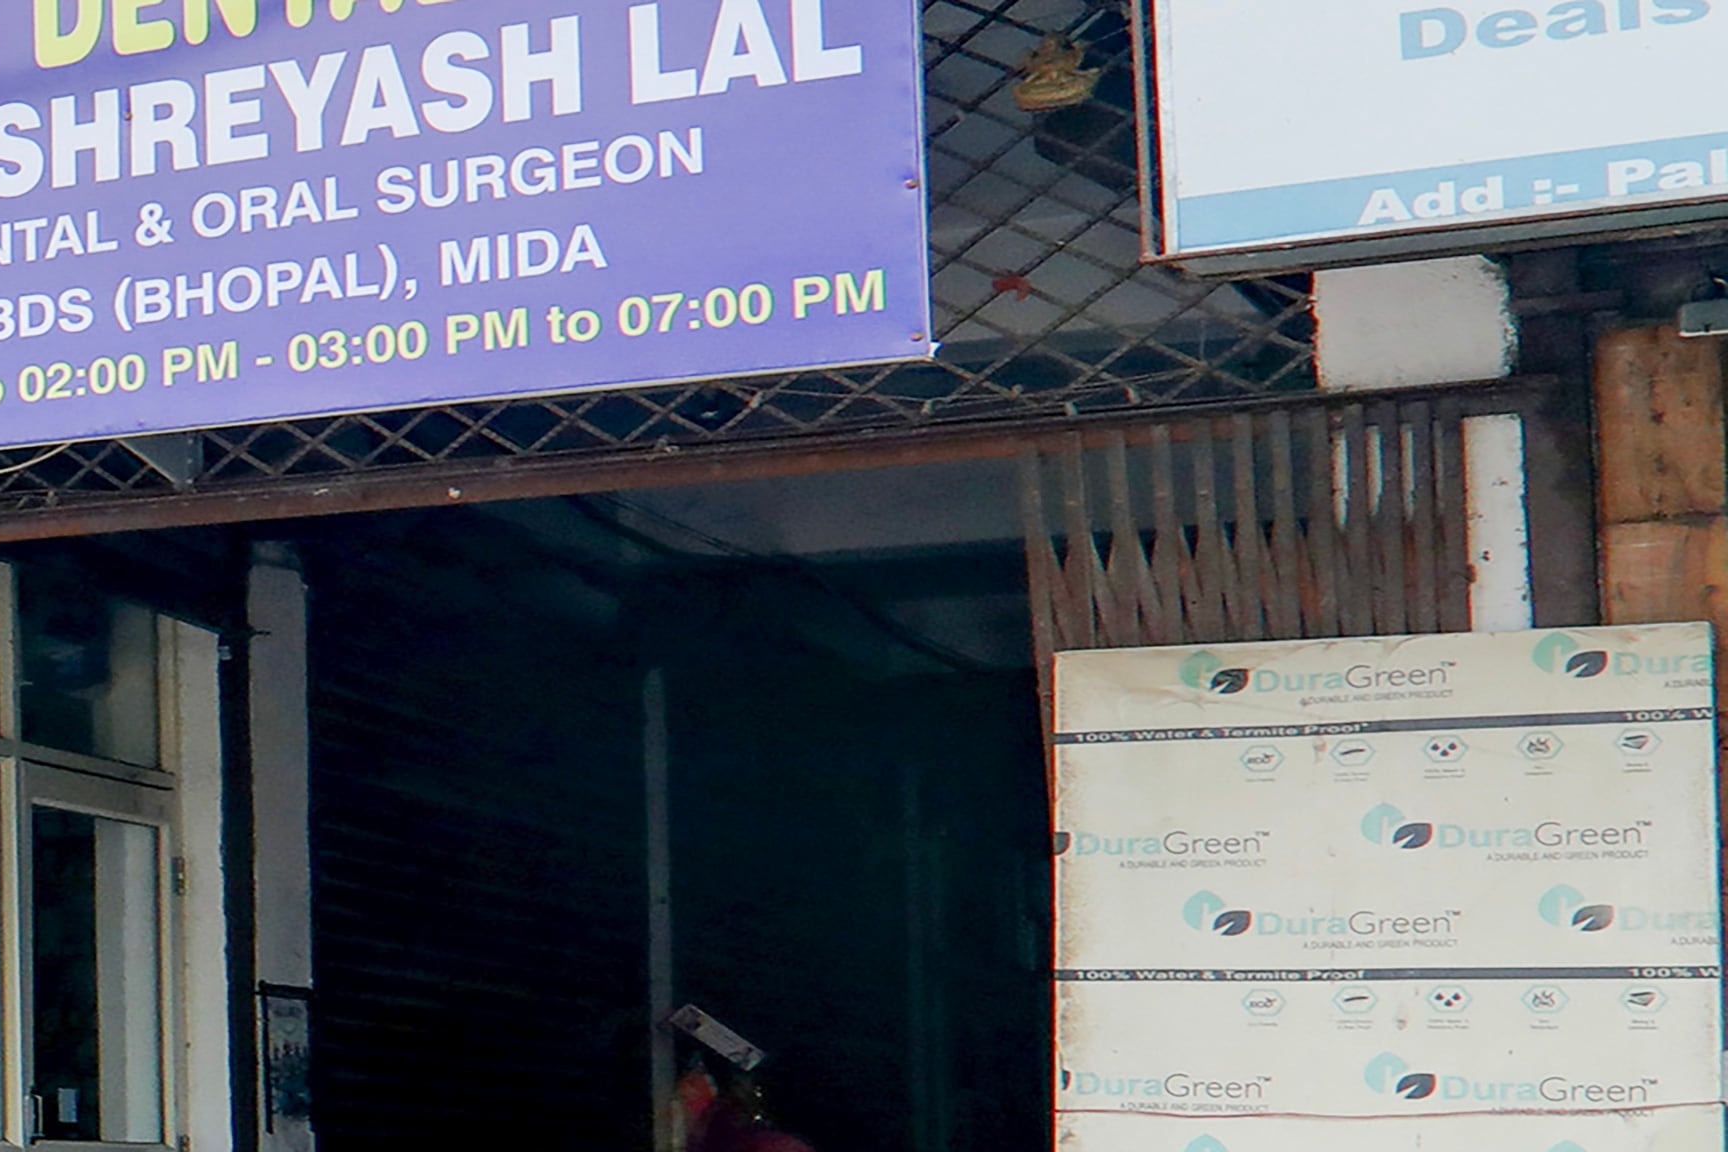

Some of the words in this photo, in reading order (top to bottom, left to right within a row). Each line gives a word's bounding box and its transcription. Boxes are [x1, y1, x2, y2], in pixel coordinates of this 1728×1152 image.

[628, 0, 863, 104] LAL
[135, 201, 174, 247] &
[191, 175, 359, 240] ORAL
[376, 127, 704, 214] SURGEON
[1357, 177, 1504, 226] Add
[114, 243, 418, 332] (BHOPAL),
[440, 224, 608, 287] MIDA
[17, 353, 146, 401] 02:00
[162, 341, 238, 387] PM
[287, 320, 429, 373] 03:00
[446, 307, 529, 356] PM
[546, 304, 601, 345] to
[618, 281, 773, 339] 07:00
[792, 268, 887, 321] PM
